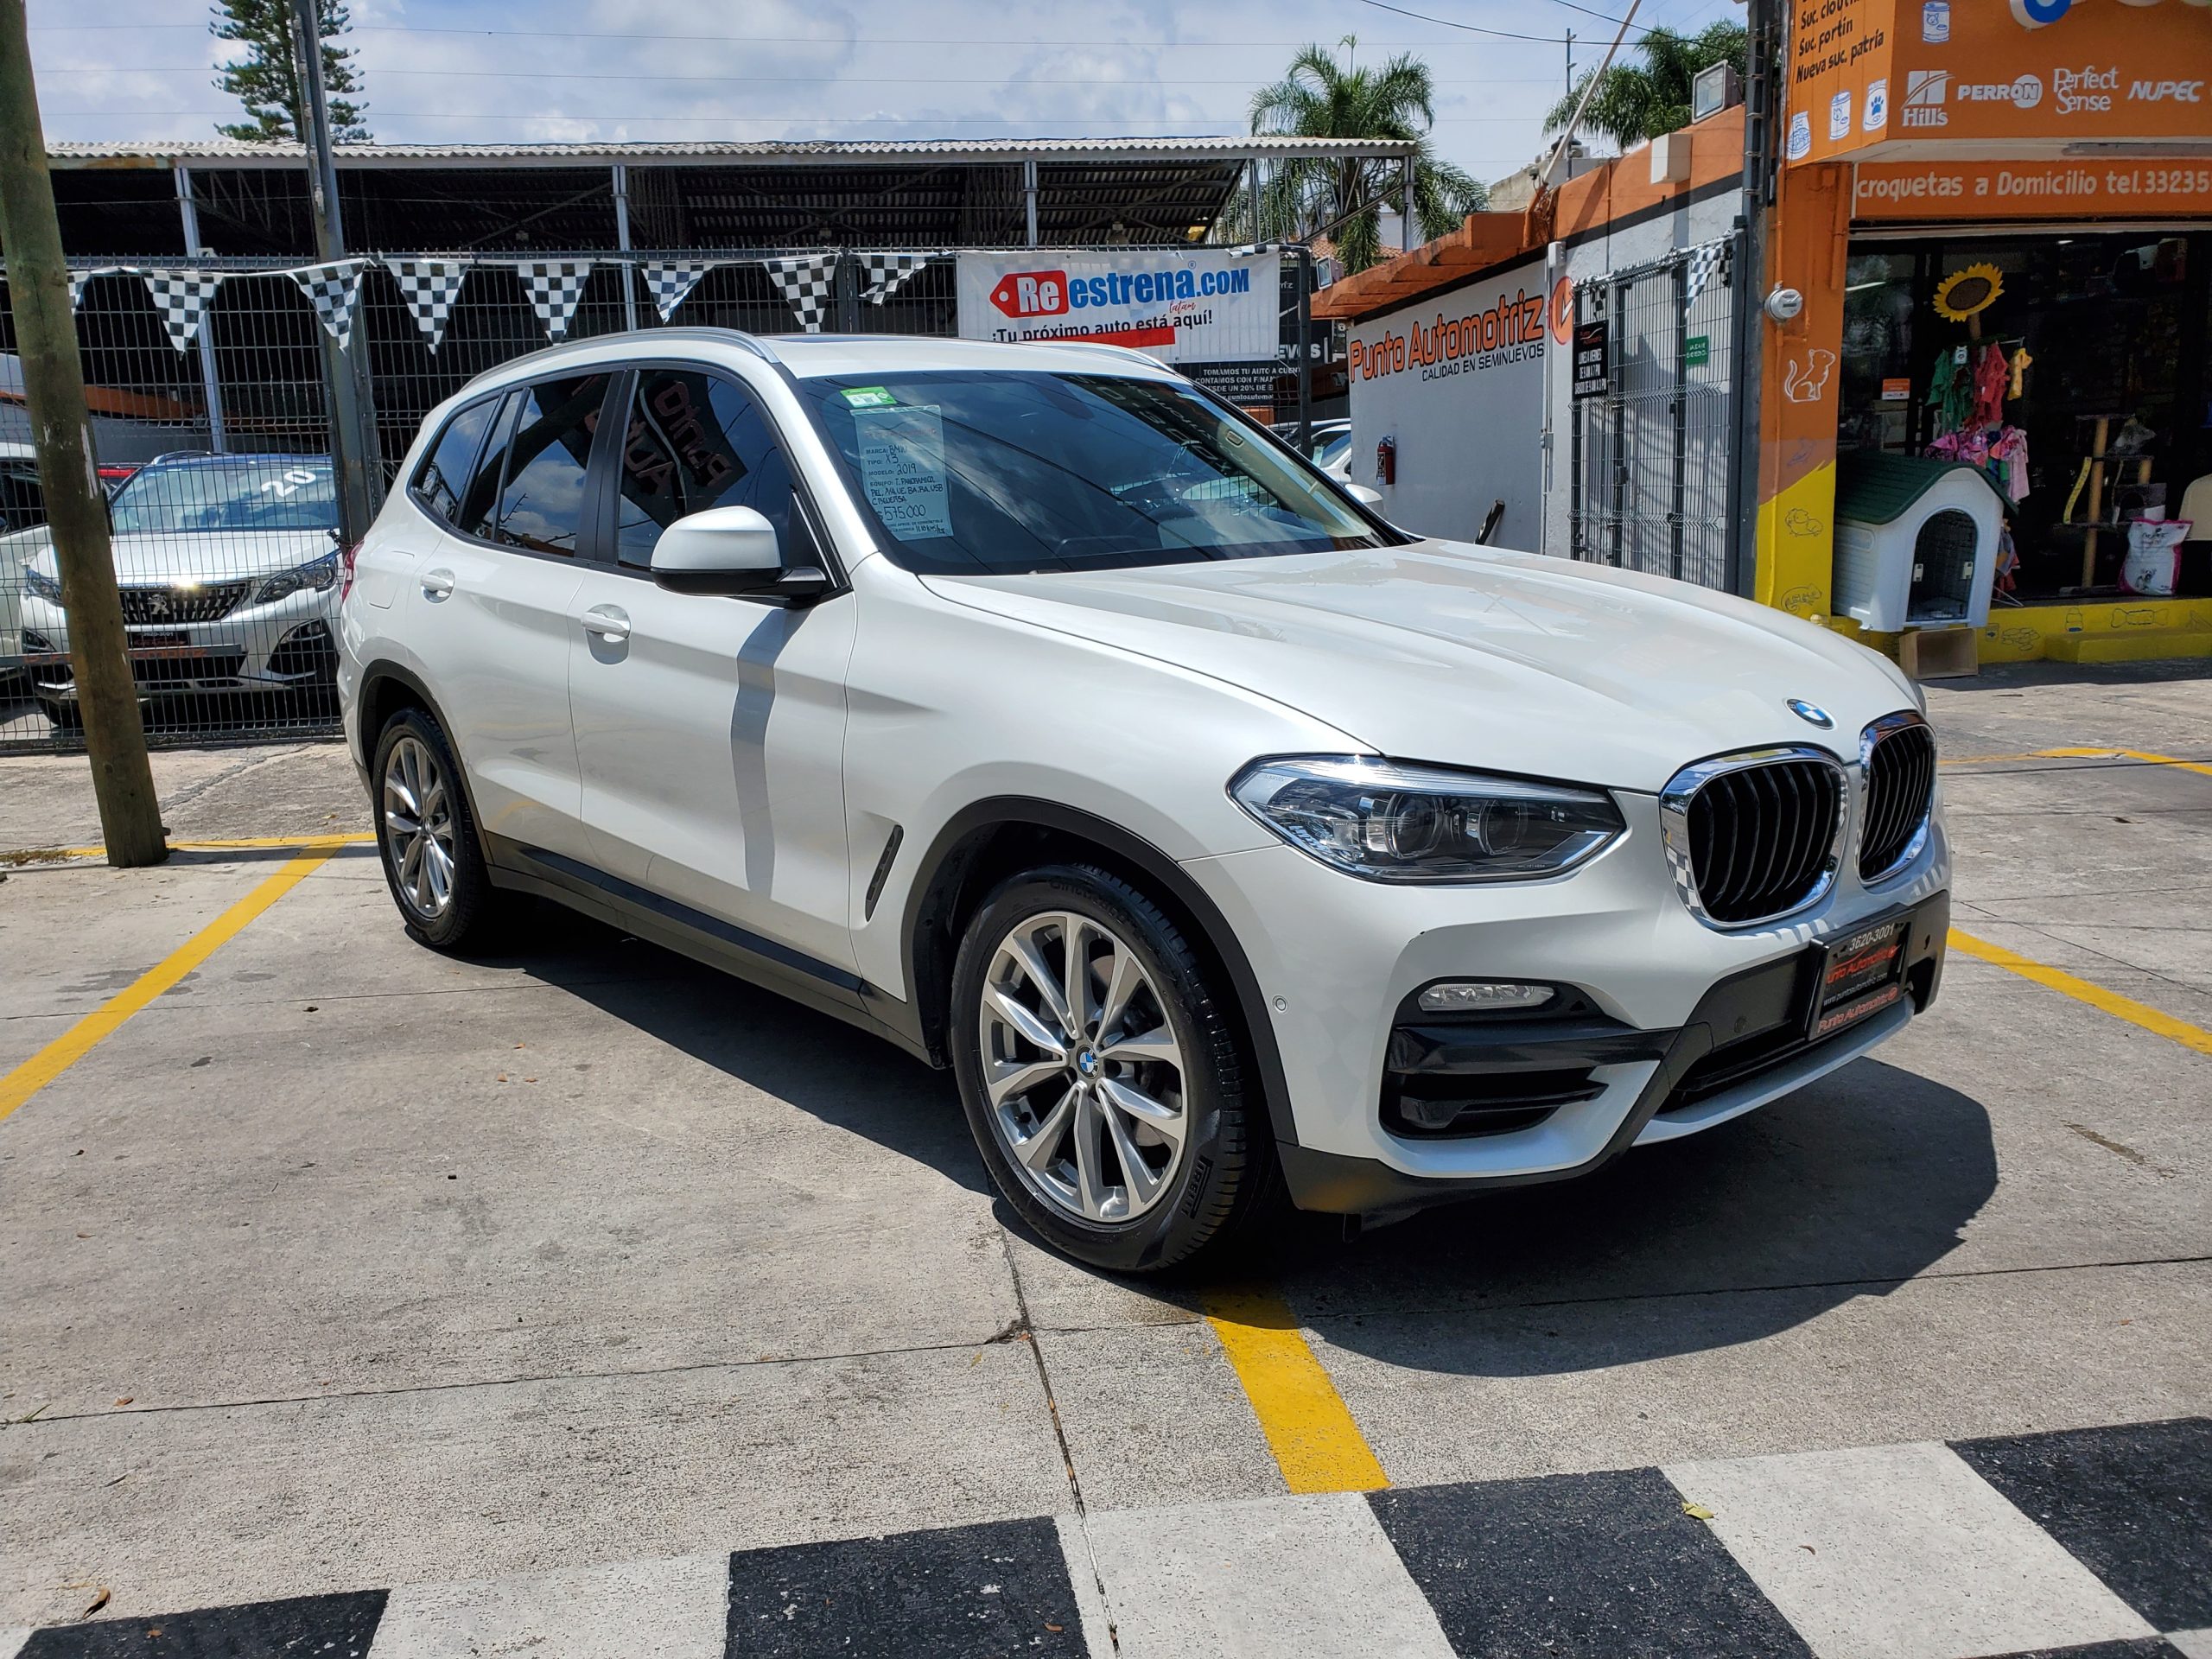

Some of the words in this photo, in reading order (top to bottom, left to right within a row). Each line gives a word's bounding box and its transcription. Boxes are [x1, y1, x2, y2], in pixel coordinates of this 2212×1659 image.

[1801, 10, 1818, 30] Suc.
[1799, 38, 1817, 57] Suc.
[1796, 59, 1827, 84] Nueva
[1827, 50, 1847, 69] suc.
[2053, 65, 2120, 92] Perfect
[1957, 83, 2040, 101] PERRON
[2056, 87, 2112, 114] Sense
[2127, 80, 2204, 102] NUPEC
[1902, 108, 1948, 127] Hill's
[1858, 171, 1964, 203] croquetas
[1974, 177, 1989, 196] a
[1997, 170, 2097, 196] Domicilio
[1169, 301, 1196, 314] latam
[1023, 323, 1090, 341] próximo
[1095, 320, 1131, 334] auto
[1136, 315, 1168, 330] está
[1173, 309, 1212, 329] aquí!
[1350, 330, 1406, 384] Punto
[1408, 288, 1545, 370] Automotriz
[1422, 363, 1460, 382] CALIDAD
[1463, 359, 1476, 373] EN
[1478, 343, 1544, 370] SEMINUEVOS
[886, 454, 899, 464] X3
[897, 462, 917, 475] 2019
[1849, 922, 1896, 951] 3620-3001
[1817, 1013, 1846, 1033] Punto
[1843, 994, 1888, 1022] Automotriz
